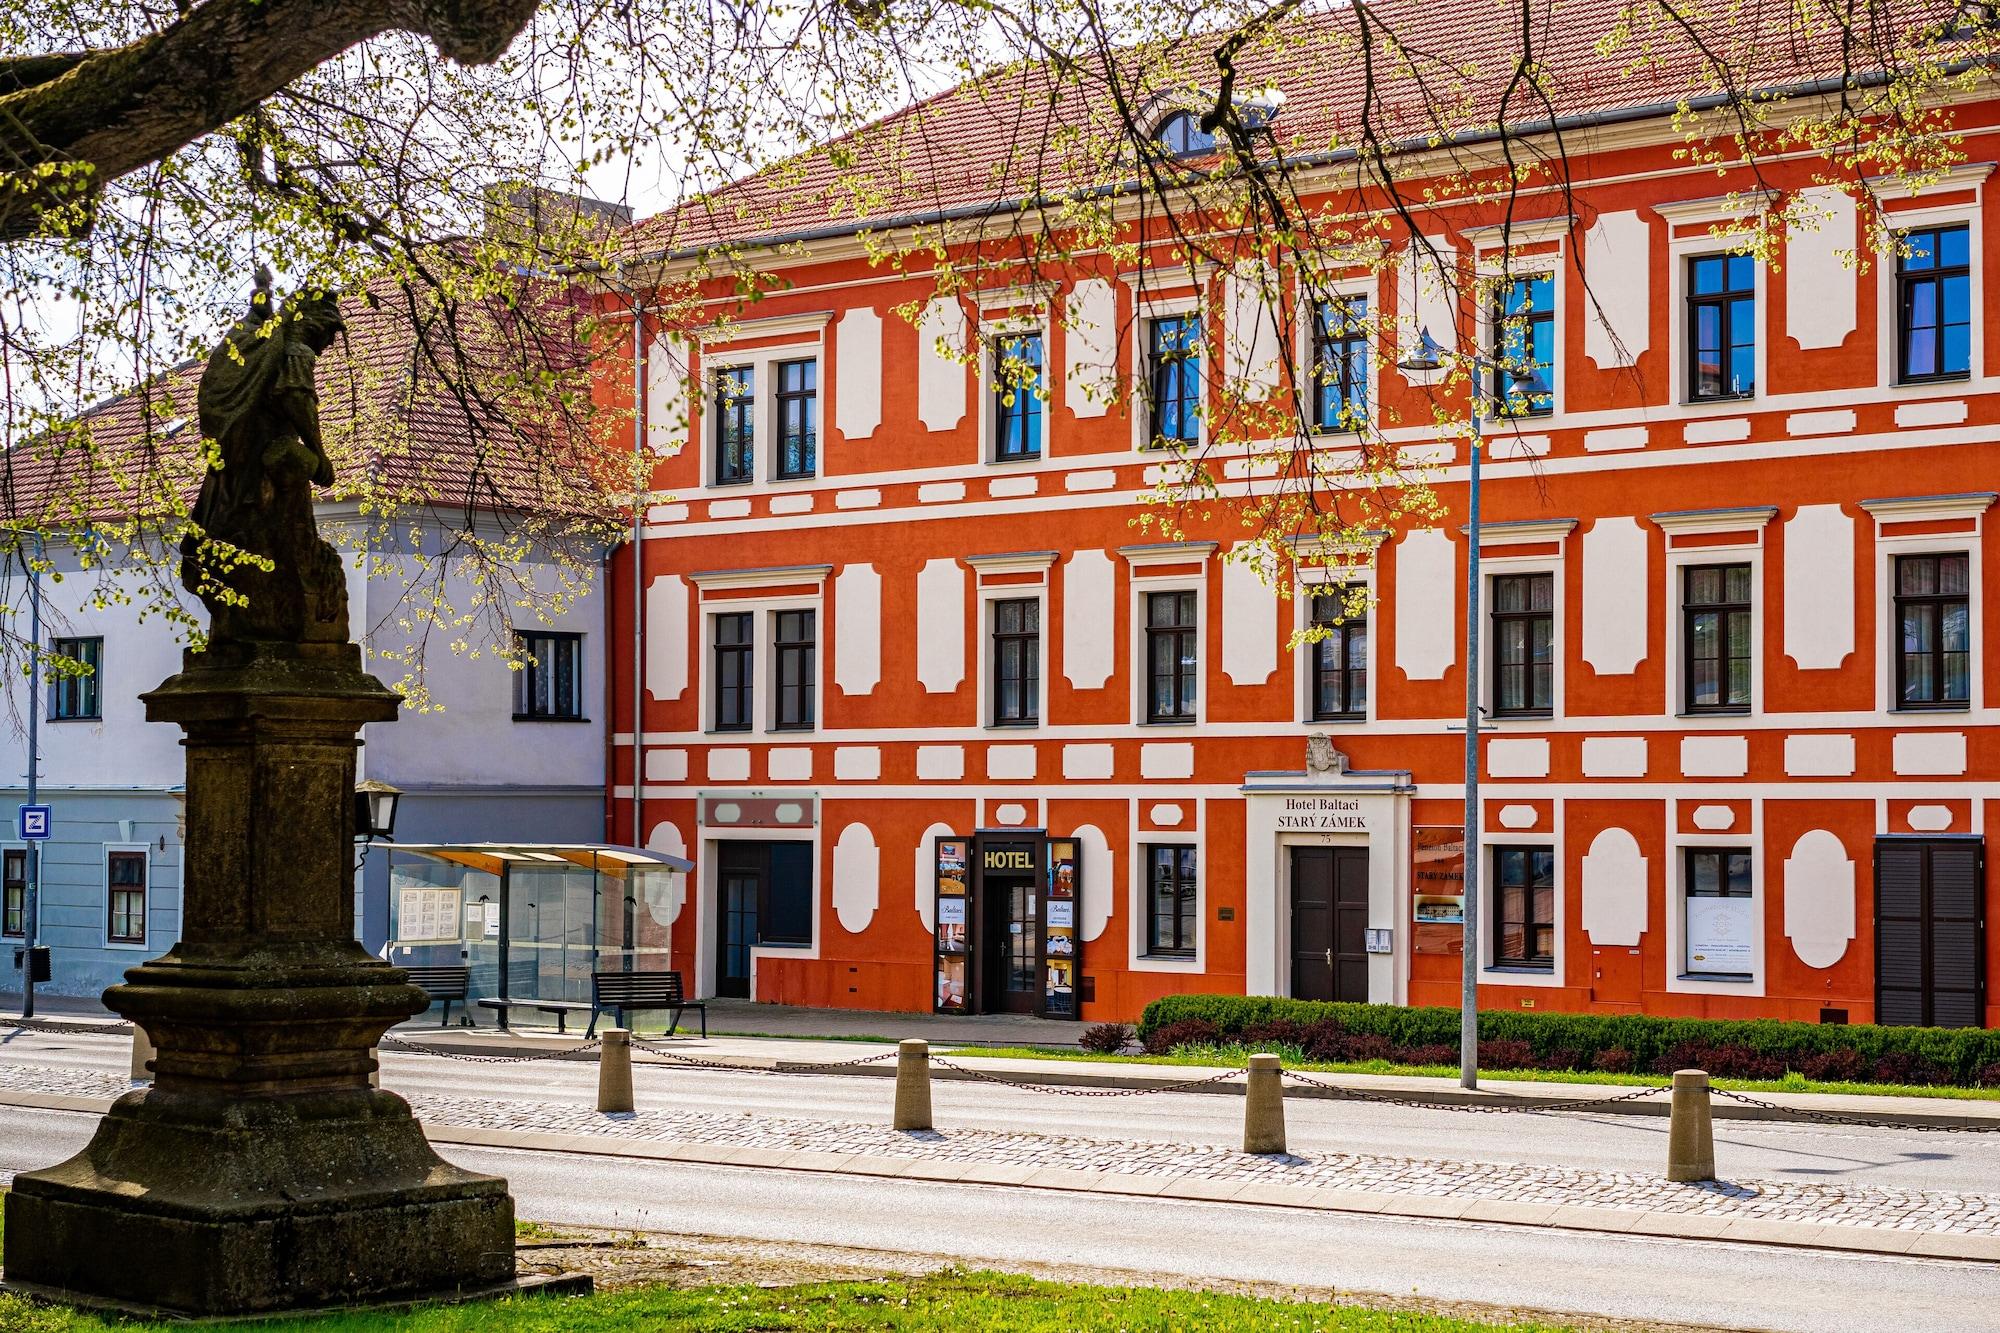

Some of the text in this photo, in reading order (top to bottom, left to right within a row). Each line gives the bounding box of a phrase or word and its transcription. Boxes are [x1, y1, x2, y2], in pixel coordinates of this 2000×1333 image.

[1286, 798, 1358, 811] Hotel Baltaci
[1278, 812, 1366, 828] STARÝ ZÁMEK
[1321, 834, 1331, 843] 75
[984, 851, 1034, 868] HOTEL
